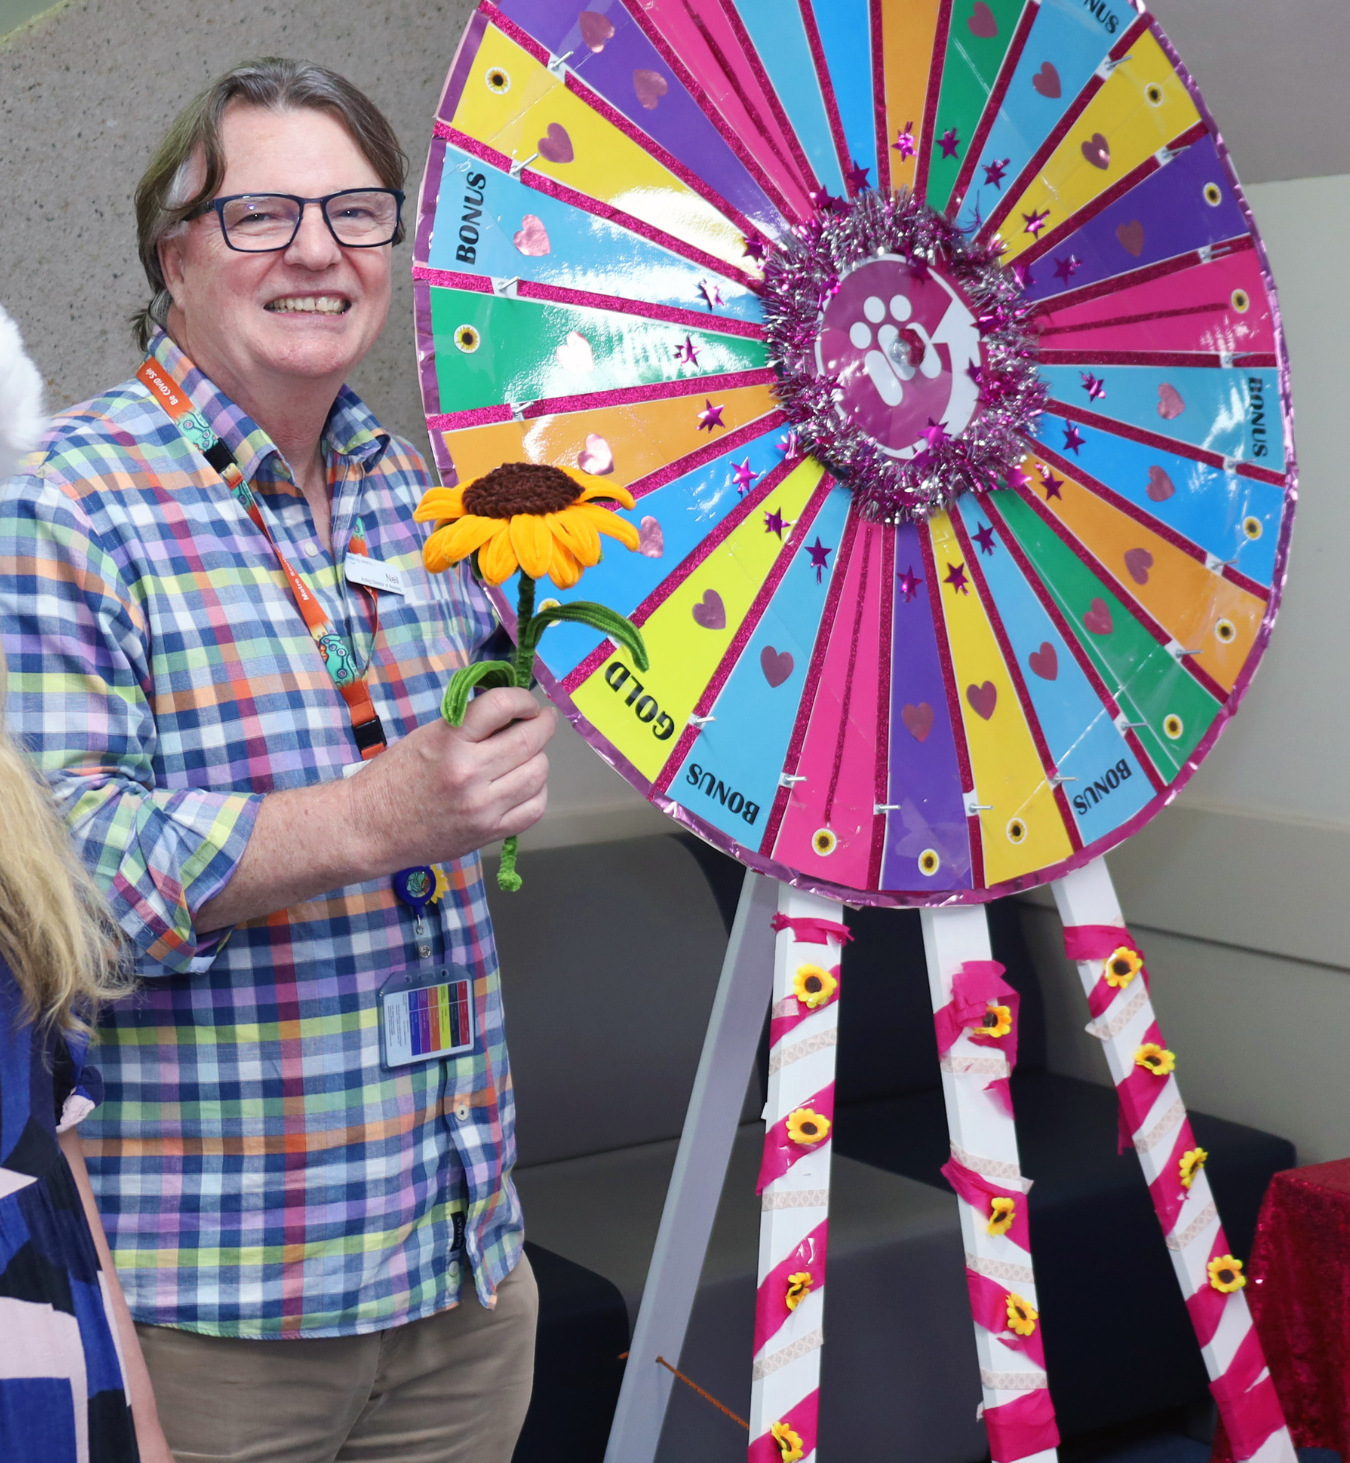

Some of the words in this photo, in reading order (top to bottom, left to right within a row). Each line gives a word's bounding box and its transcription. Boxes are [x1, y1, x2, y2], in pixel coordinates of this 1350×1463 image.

[1083, 0, 1120, 34] NUS
[455, 171, 487, 266] BONUS
[145, 367, 158, 379] Safe
[153, 377, 171, 396] COVID
[169, 394, 179, 406] Be
[1248, 377, 1268, 457] BONUS
[294, 578, 309, 601] Metro
[604, 661, 675, 741] GOLD
[685, 763, 760, 826] BONUS
[1073, 758, 1132, 816] BONUS
